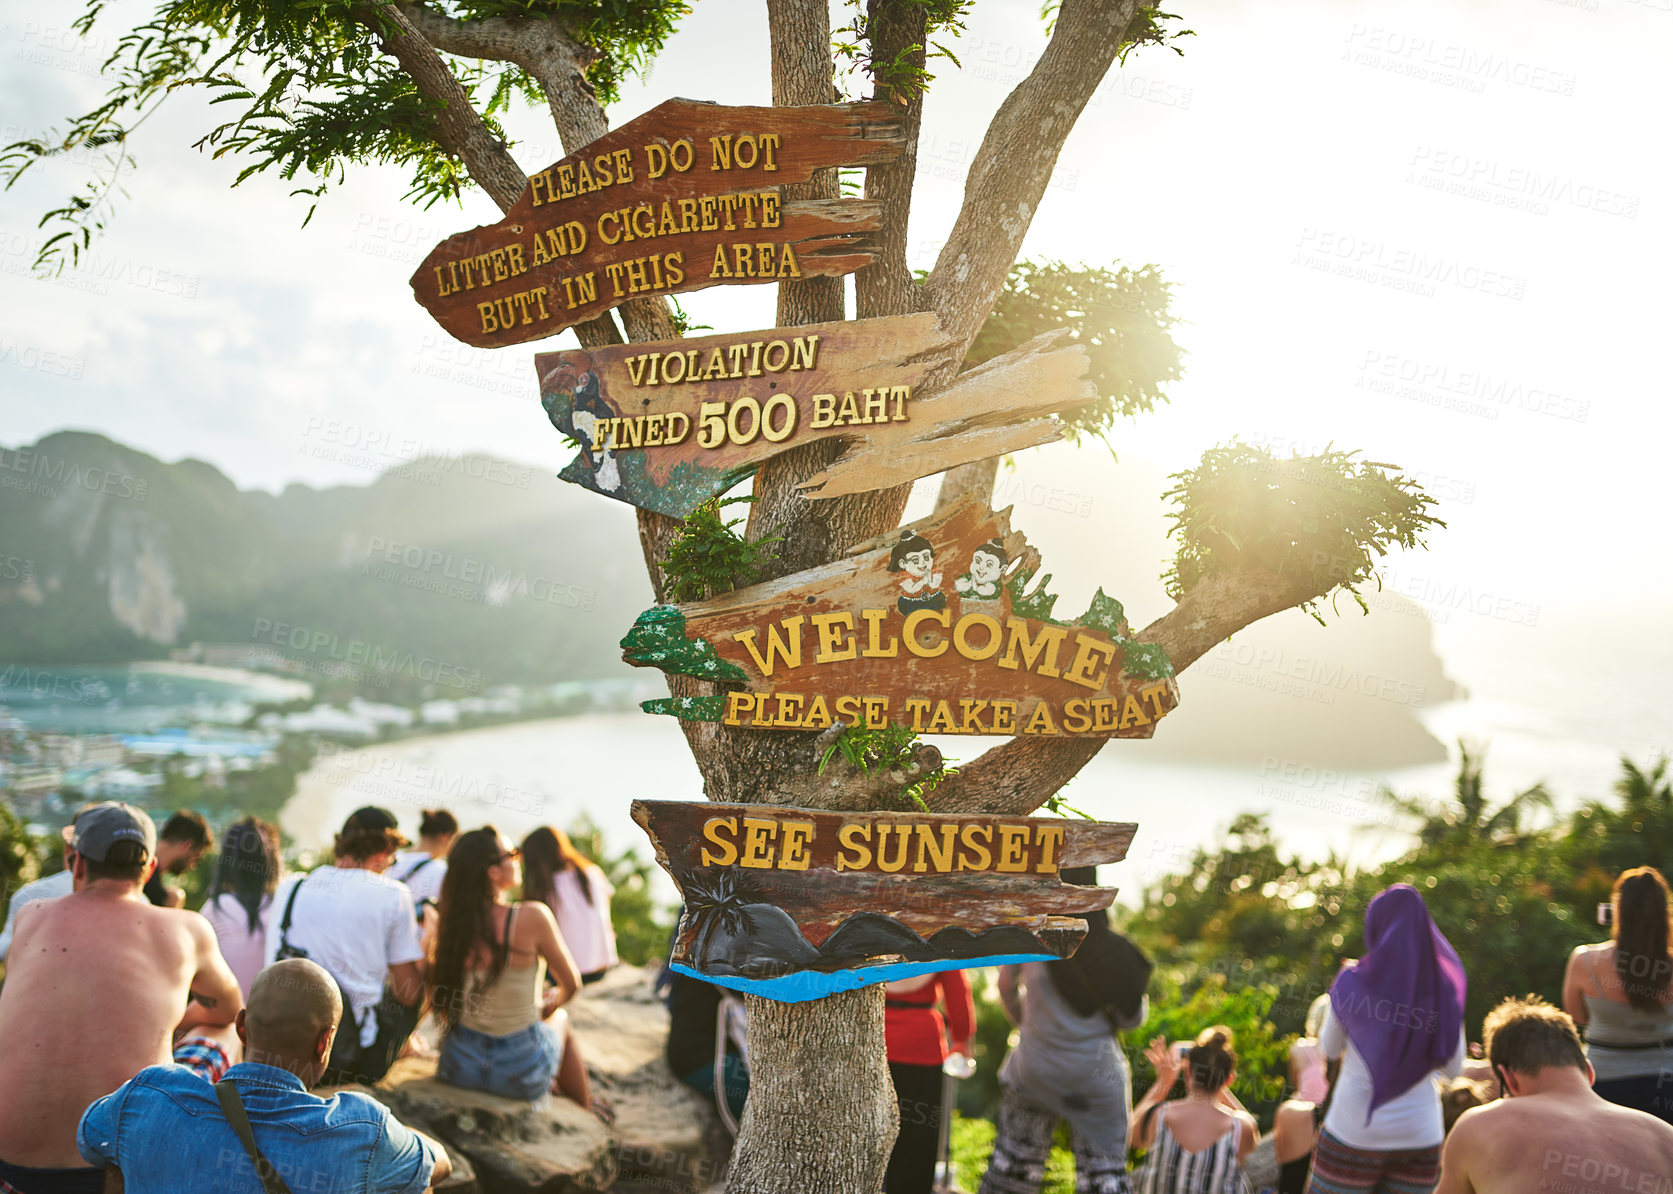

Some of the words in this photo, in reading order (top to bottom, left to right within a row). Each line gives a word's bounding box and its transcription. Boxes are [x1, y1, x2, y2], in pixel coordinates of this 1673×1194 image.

[529, 149, 634, 207] PLEASE
[647, 141, 694, 180] DO
[710, 133, 780, 171] NOT
[434, 247, 528, 297] LITTER
[533, 222, 588, 267] AND
[598, 191, 781, 244] CIGARETTE
[476, 287, 549, 334] BUTT
[566, 274, 596, 309] IN
[605, 252, 685, 297] THIS
[709, 242, 801, 279] AREA
[625, 334, 818, 386] VIOLATION
[591, 411, 689, 451] FINED
[697, 394, 796, 449] 500
[810, 385, 910, 430] BAHT
[733, 609, 1117, 690] WELCOME
[724, 691, 889, 731] PLEASE
[905, 698, 1016, 735] TAKE
[1024, 700, 1058, 735] A
[1062, 683, 1168, 733] SEAT
[701, 817, 813, 871] SEE
[837, 823, 1064, 874] SUNSET
